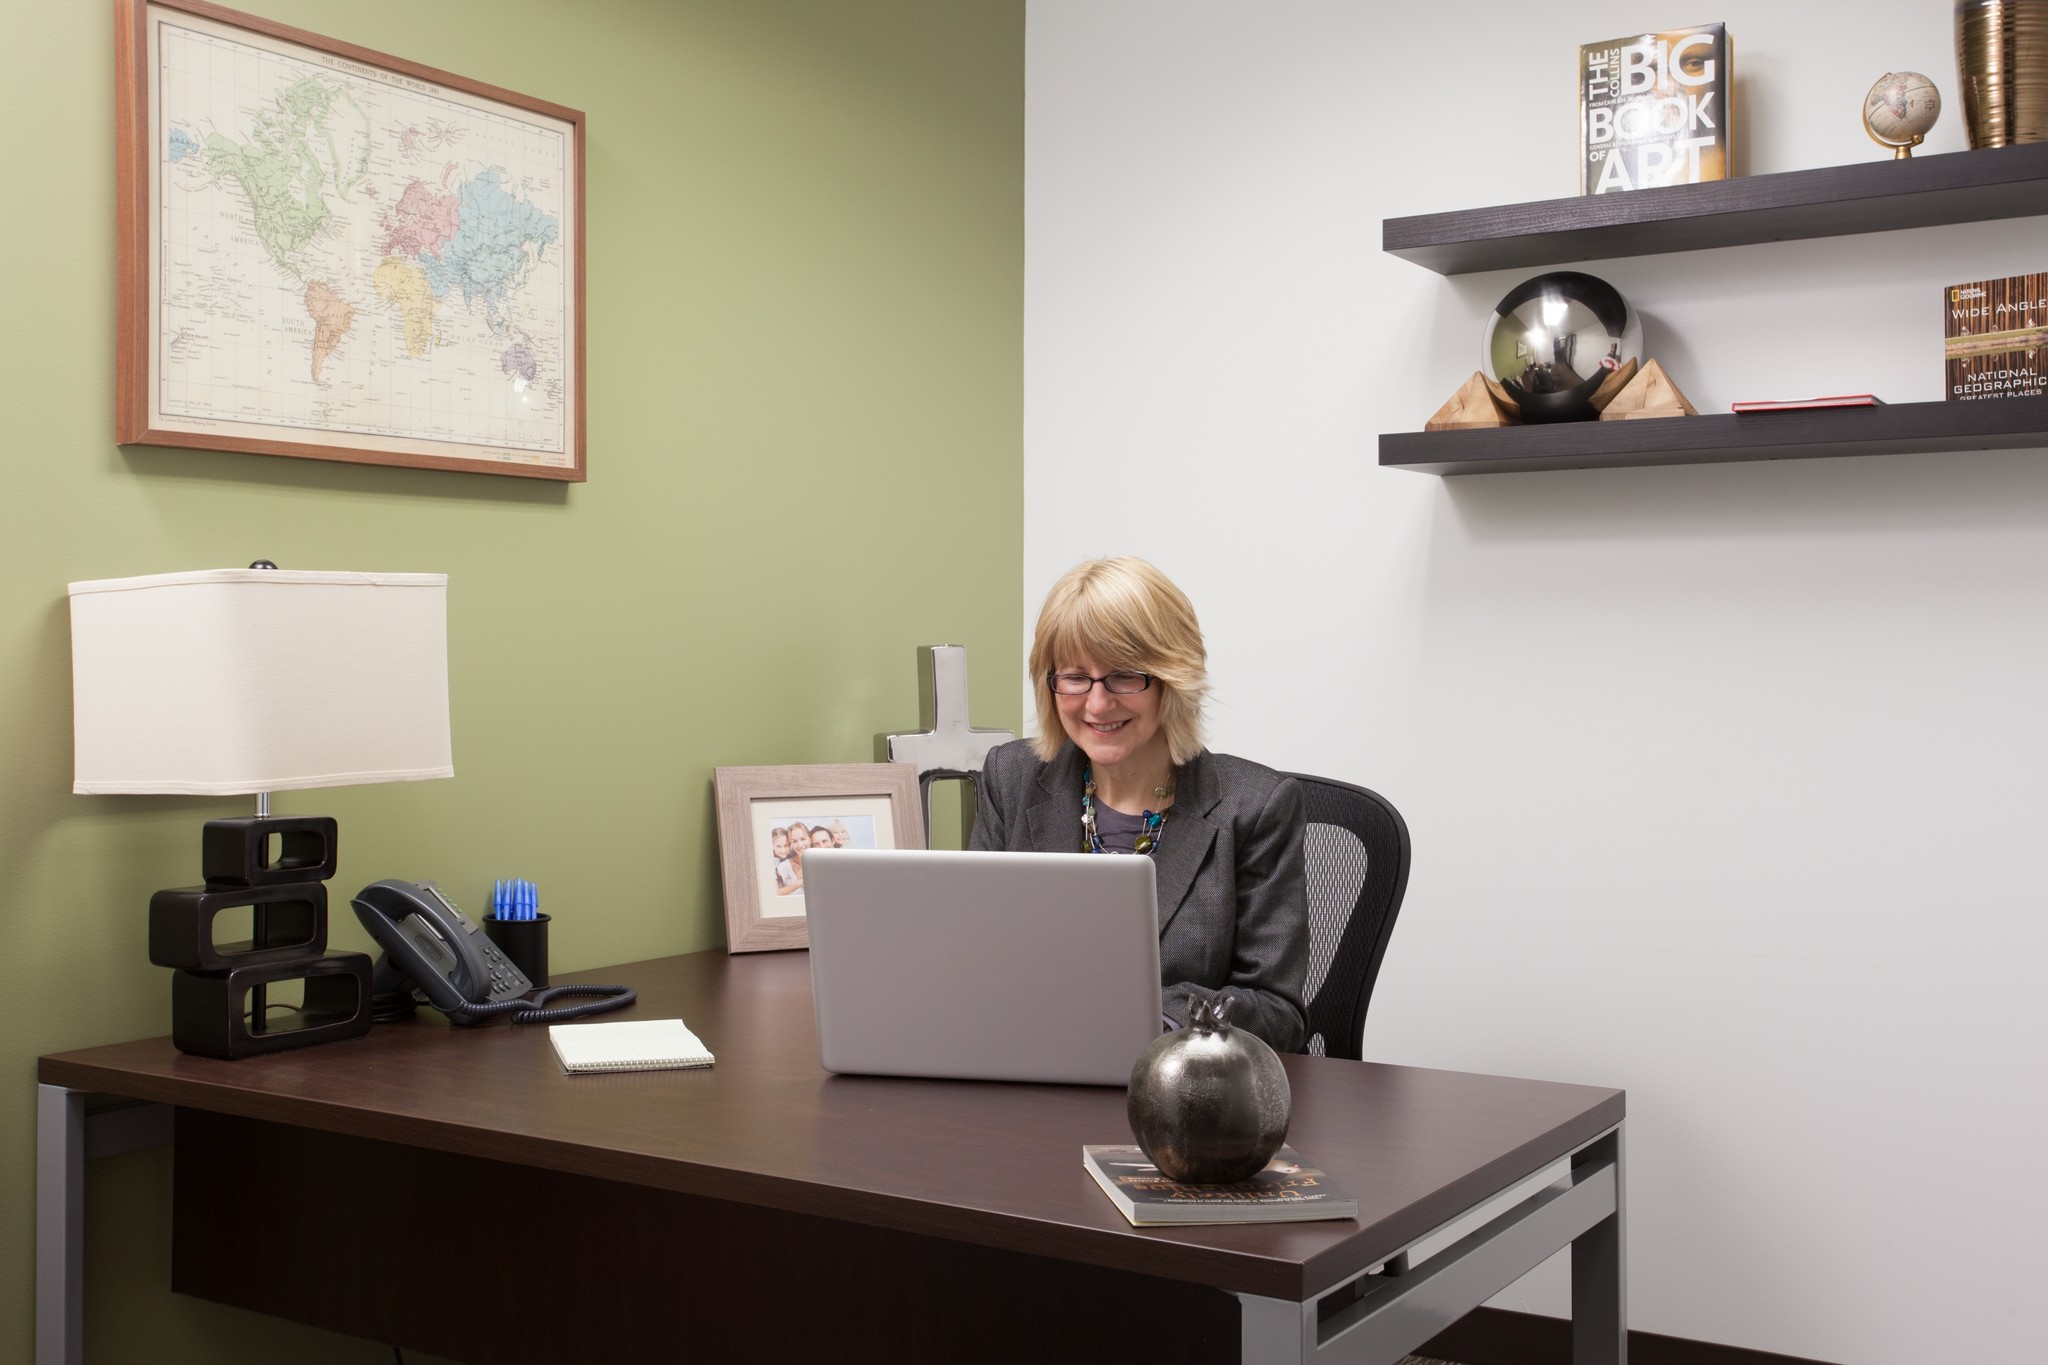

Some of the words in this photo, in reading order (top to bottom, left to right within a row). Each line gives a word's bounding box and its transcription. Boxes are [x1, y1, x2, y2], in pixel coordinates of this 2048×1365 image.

[322, 56, 334, 65] THE
[337, 61, 377, 77] CONTINENTS
[380, 71, 389, 80] OF
[391, 76, 403, 84] THE
[406, 80, 426, 91] WORLD
[1589, 49, 1608, 100] THE
[1610, 48, 1620, 97] COLLINS
[1621, 34, 1715, 96] BIG
[1589, 92, 1716, 145] BOOK
[1589, 150, 1606, 162] OF
[1595, 136, 1716, 195] ART
[1952, 307, 1989, 319] WIDE
[1996, 299, 2047, 314] ANGLE
[1954, 377, 2047, 394] GEOGRAPHIC
[1968, 368, 2037, 382] NATIONAL
[2007, 389, 2042, 398] PLACES
